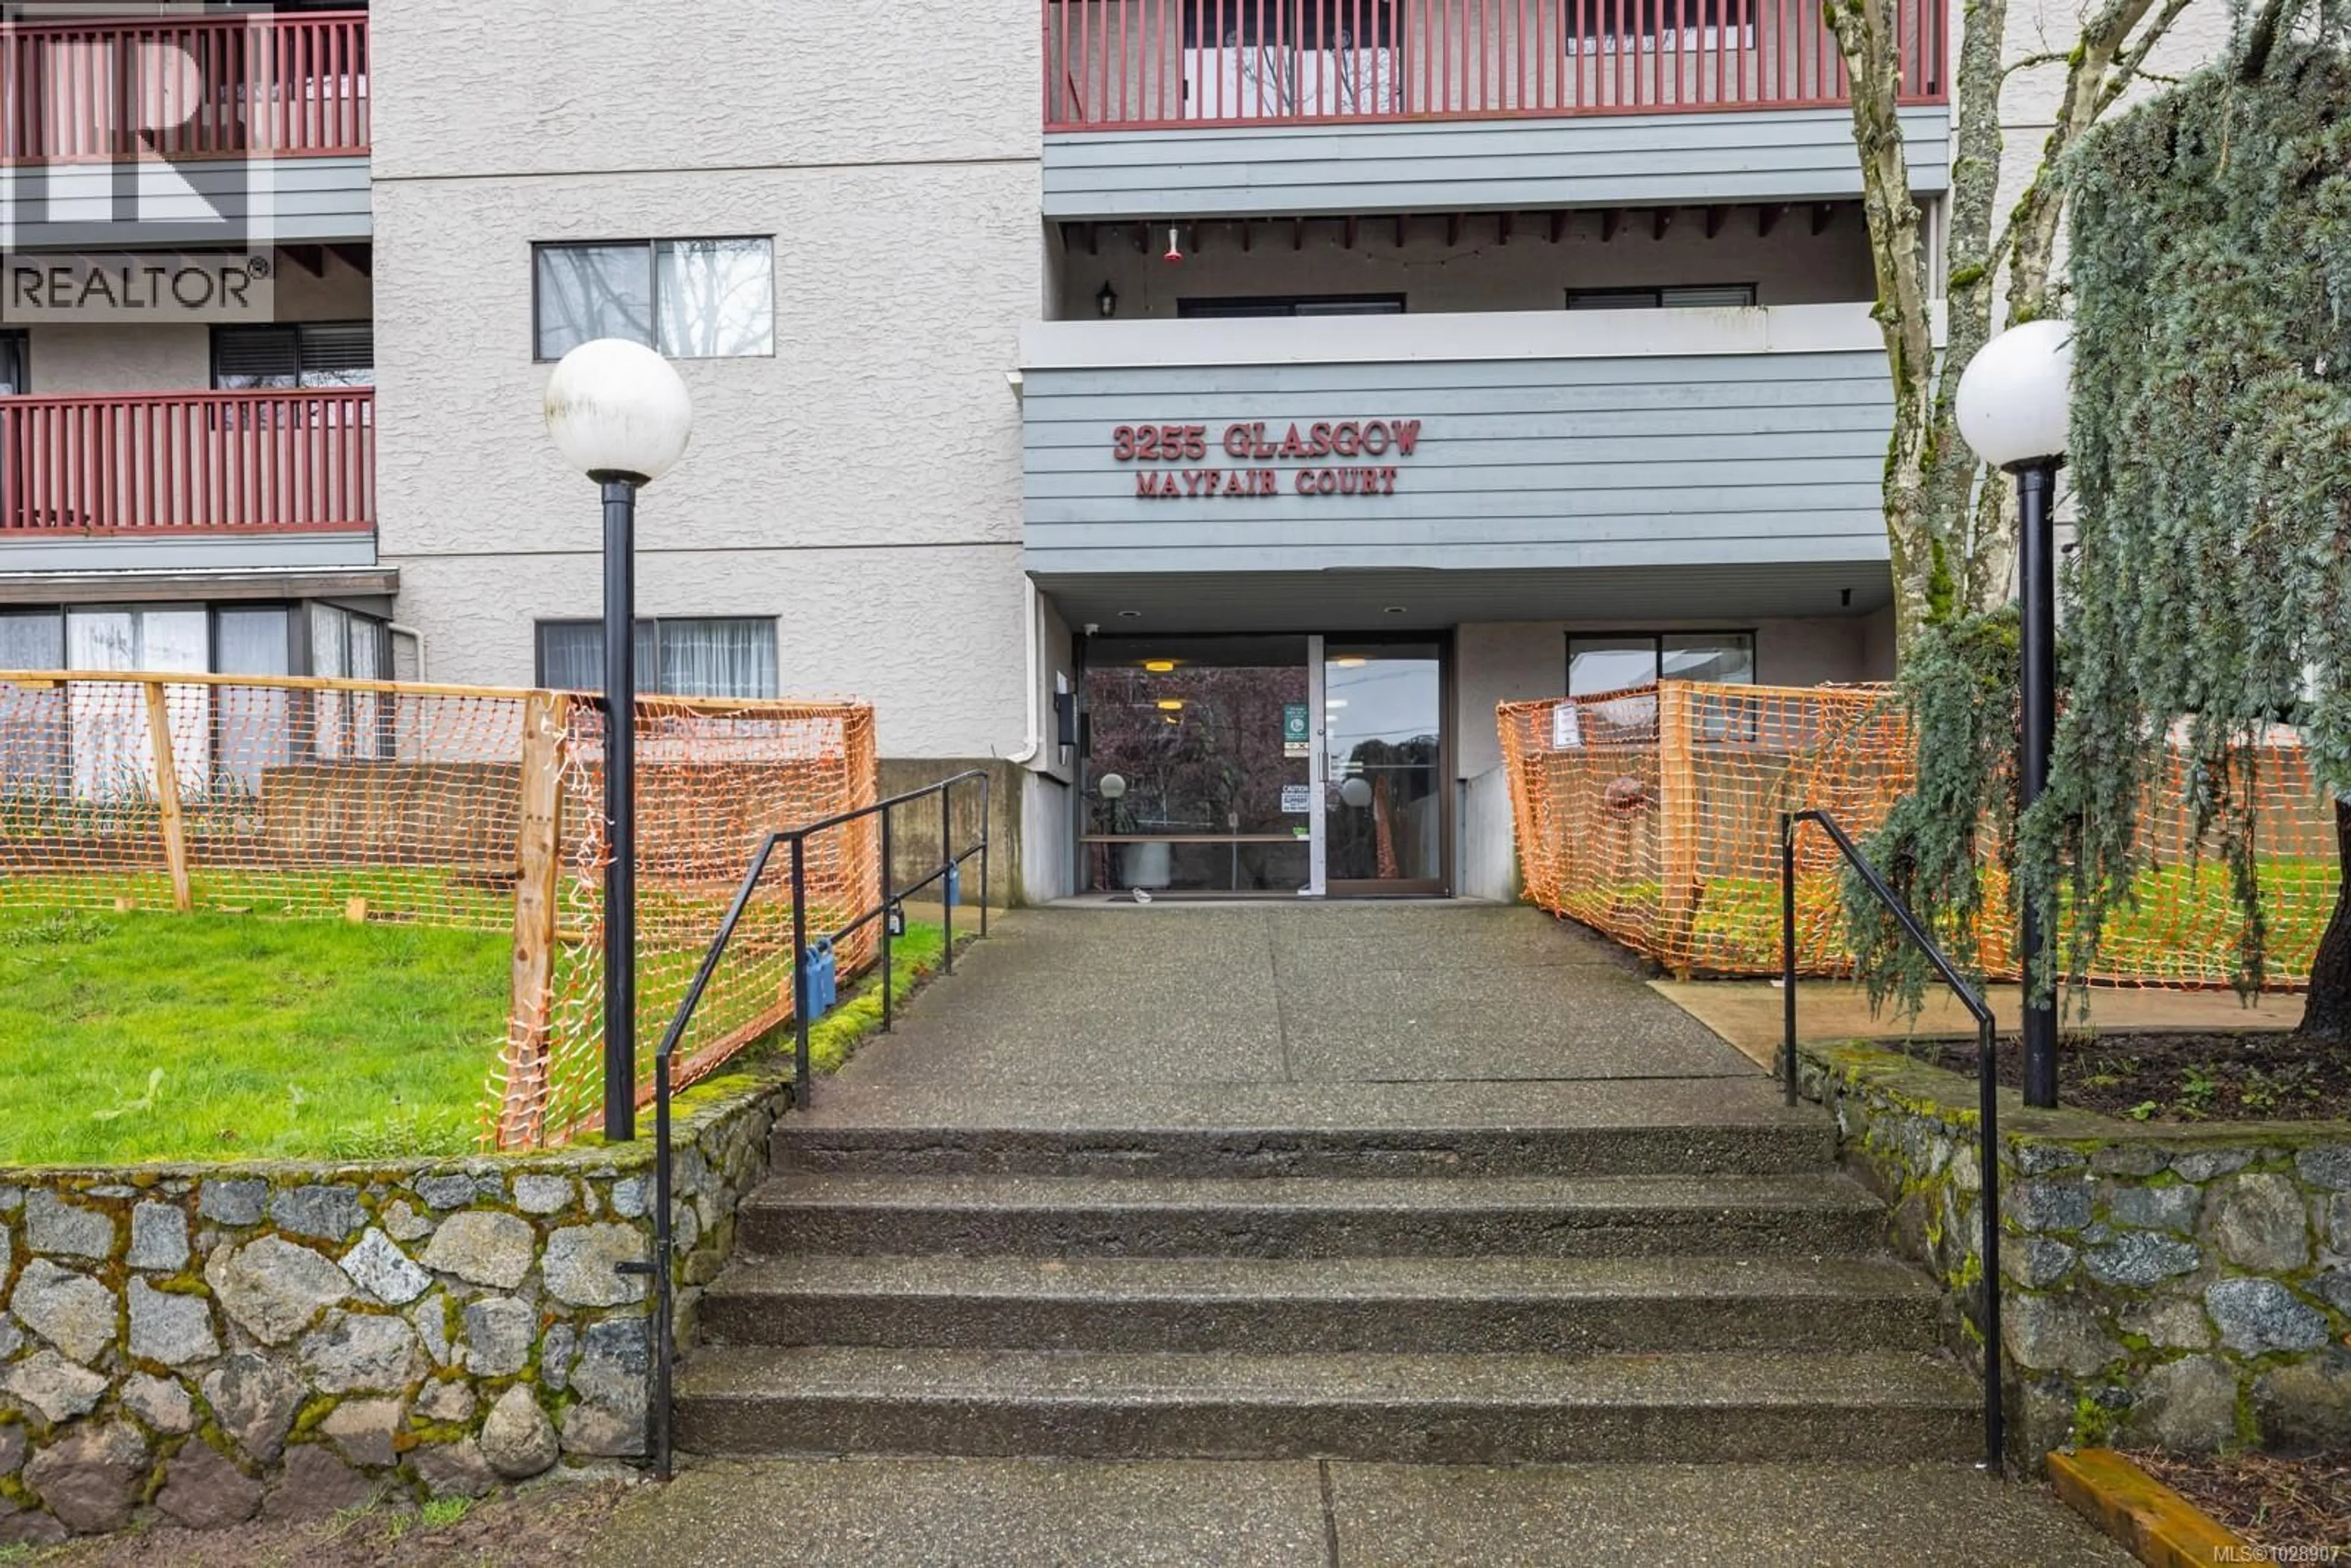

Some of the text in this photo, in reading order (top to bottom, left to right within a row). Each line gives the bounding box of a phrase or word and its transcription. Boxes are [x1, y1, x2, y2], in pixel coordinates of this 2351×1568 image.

[1113, 421, 1420, 461] 3255 GLASGOW
[1136, 467, 1398, 498] MAYFAIR COURT
